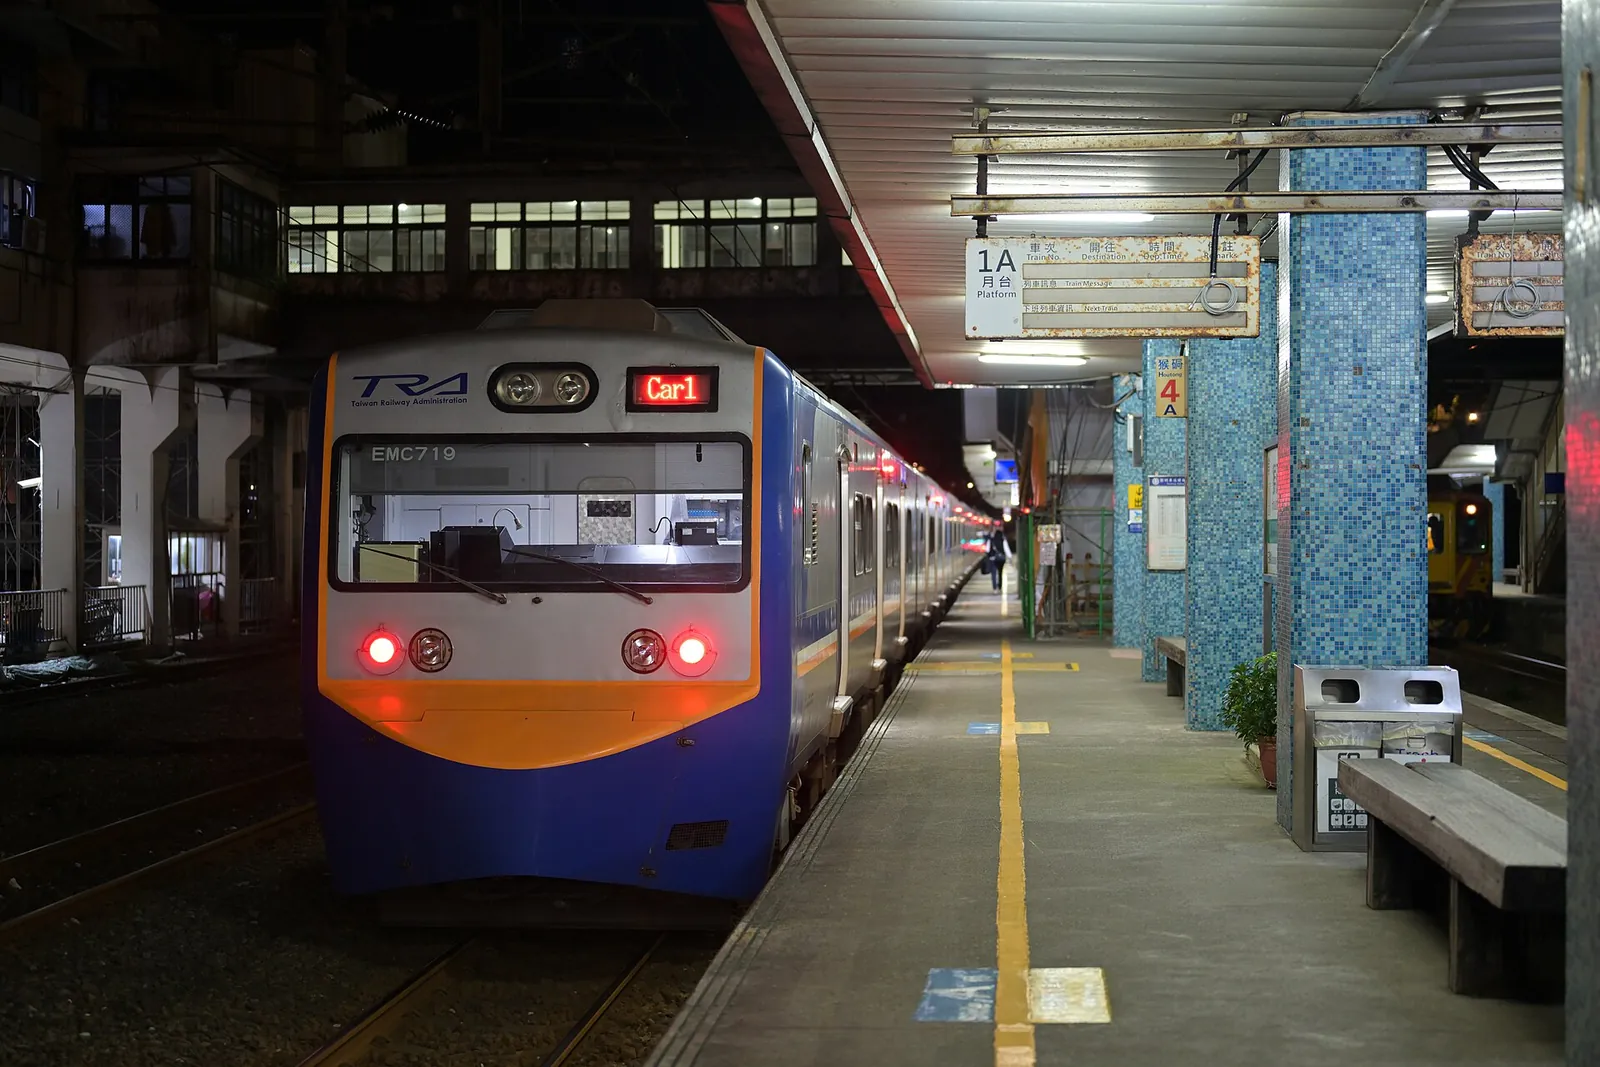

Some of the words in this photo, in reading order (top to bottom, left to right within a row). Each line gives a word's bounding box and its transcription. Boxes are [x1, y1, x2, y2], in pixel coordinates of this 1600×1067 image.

[1030, 242, 1056, 253] 車次
[1089, 242, 1115, 253] 開往
[1148, 242, 1175, 252] 時間
[978, 249, 1017, 273] 1A
[982, 276, 1012, 288] 月台
[1023, 280, 1057, 288] 列車訊息
[977, 290, 1018, 299] Platform
[352, 372, 468, 398] TRA
[1160, 379, 1180, 403] 4
[413, 397, 468, 405] Administration
[1163, 404, 1177, 415] A
[372, 446, 456, 462] EMC719
